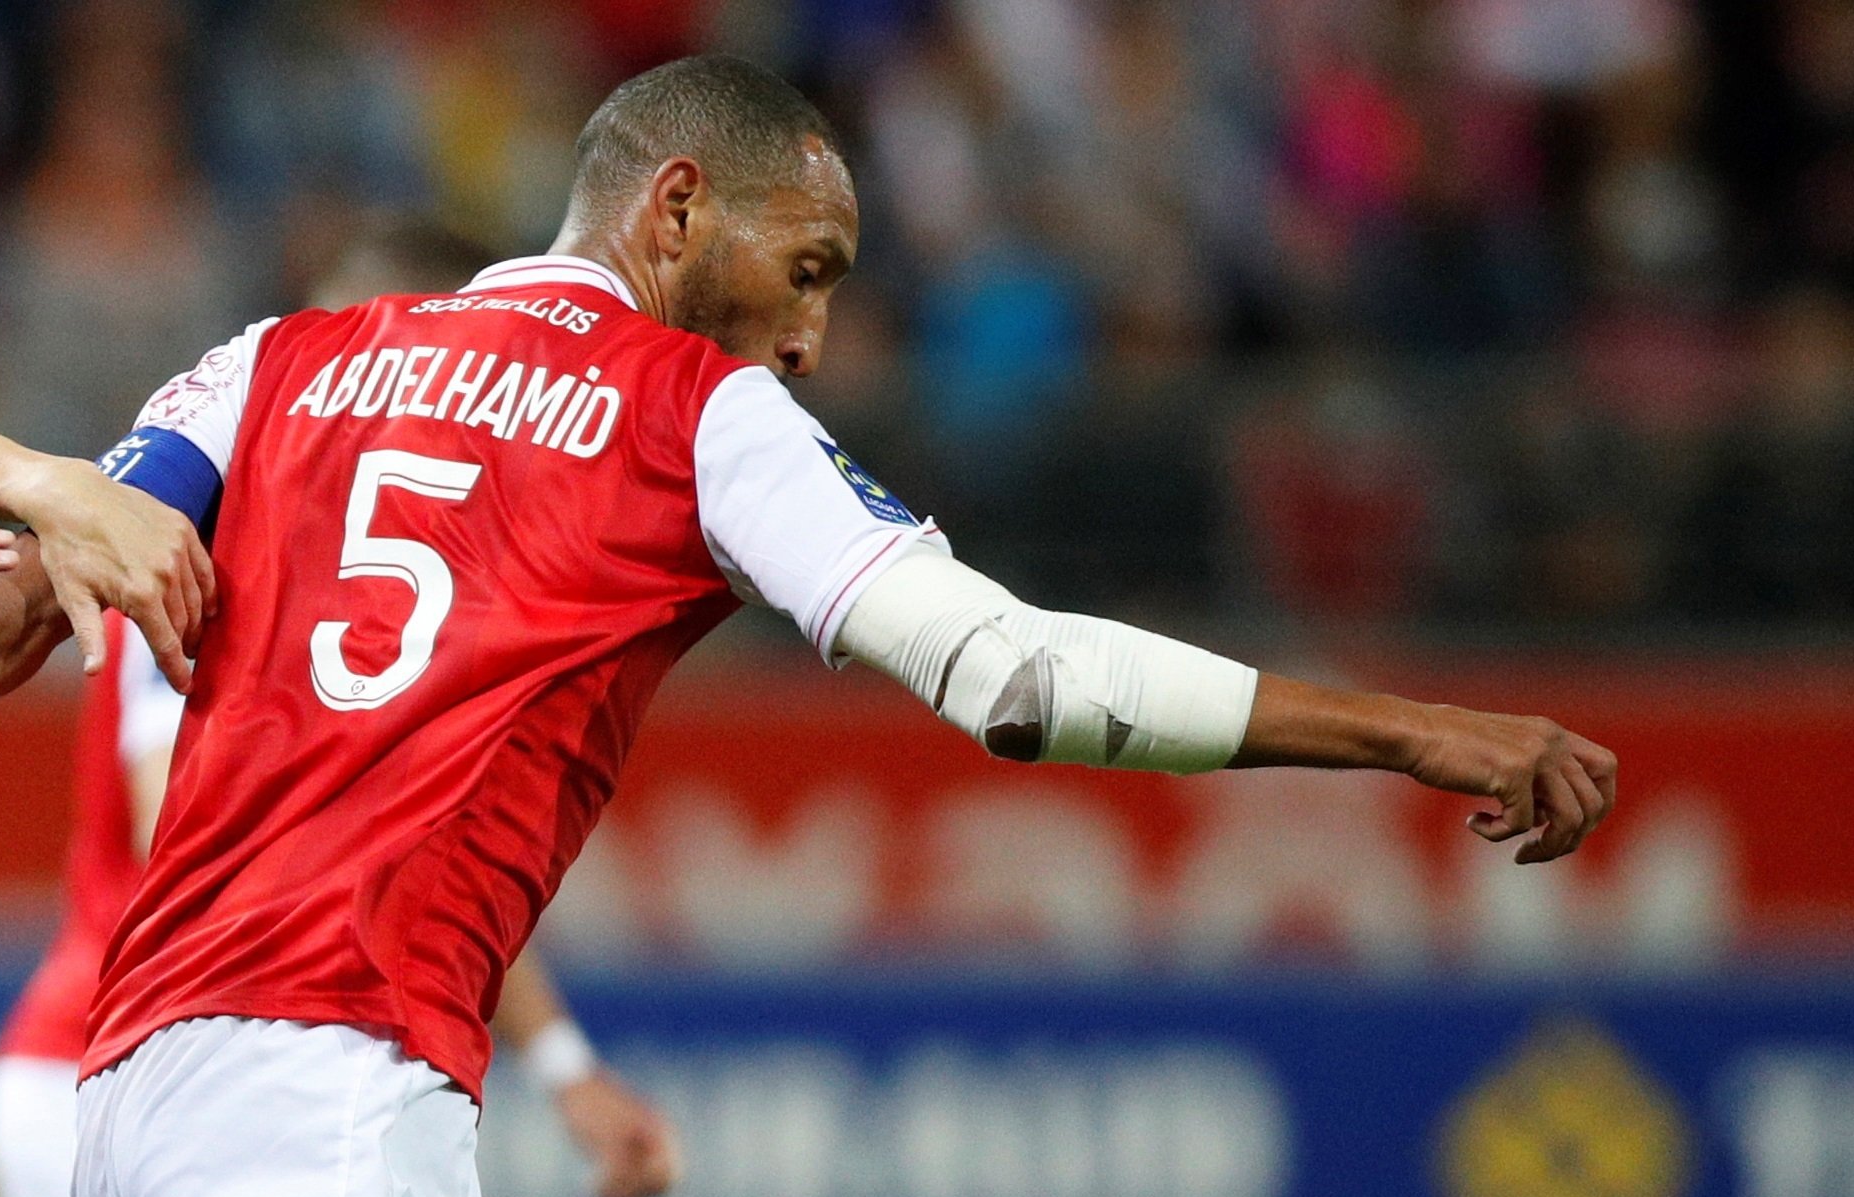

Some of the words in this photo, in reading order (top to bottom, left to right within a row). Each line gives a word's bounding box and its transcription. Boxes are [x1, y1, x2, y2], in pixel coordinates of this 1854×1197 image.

[408, 296, 483, 314] SOS
[473, 297, 601, 335] MALUS
[308, 448, 484, 712] 5
